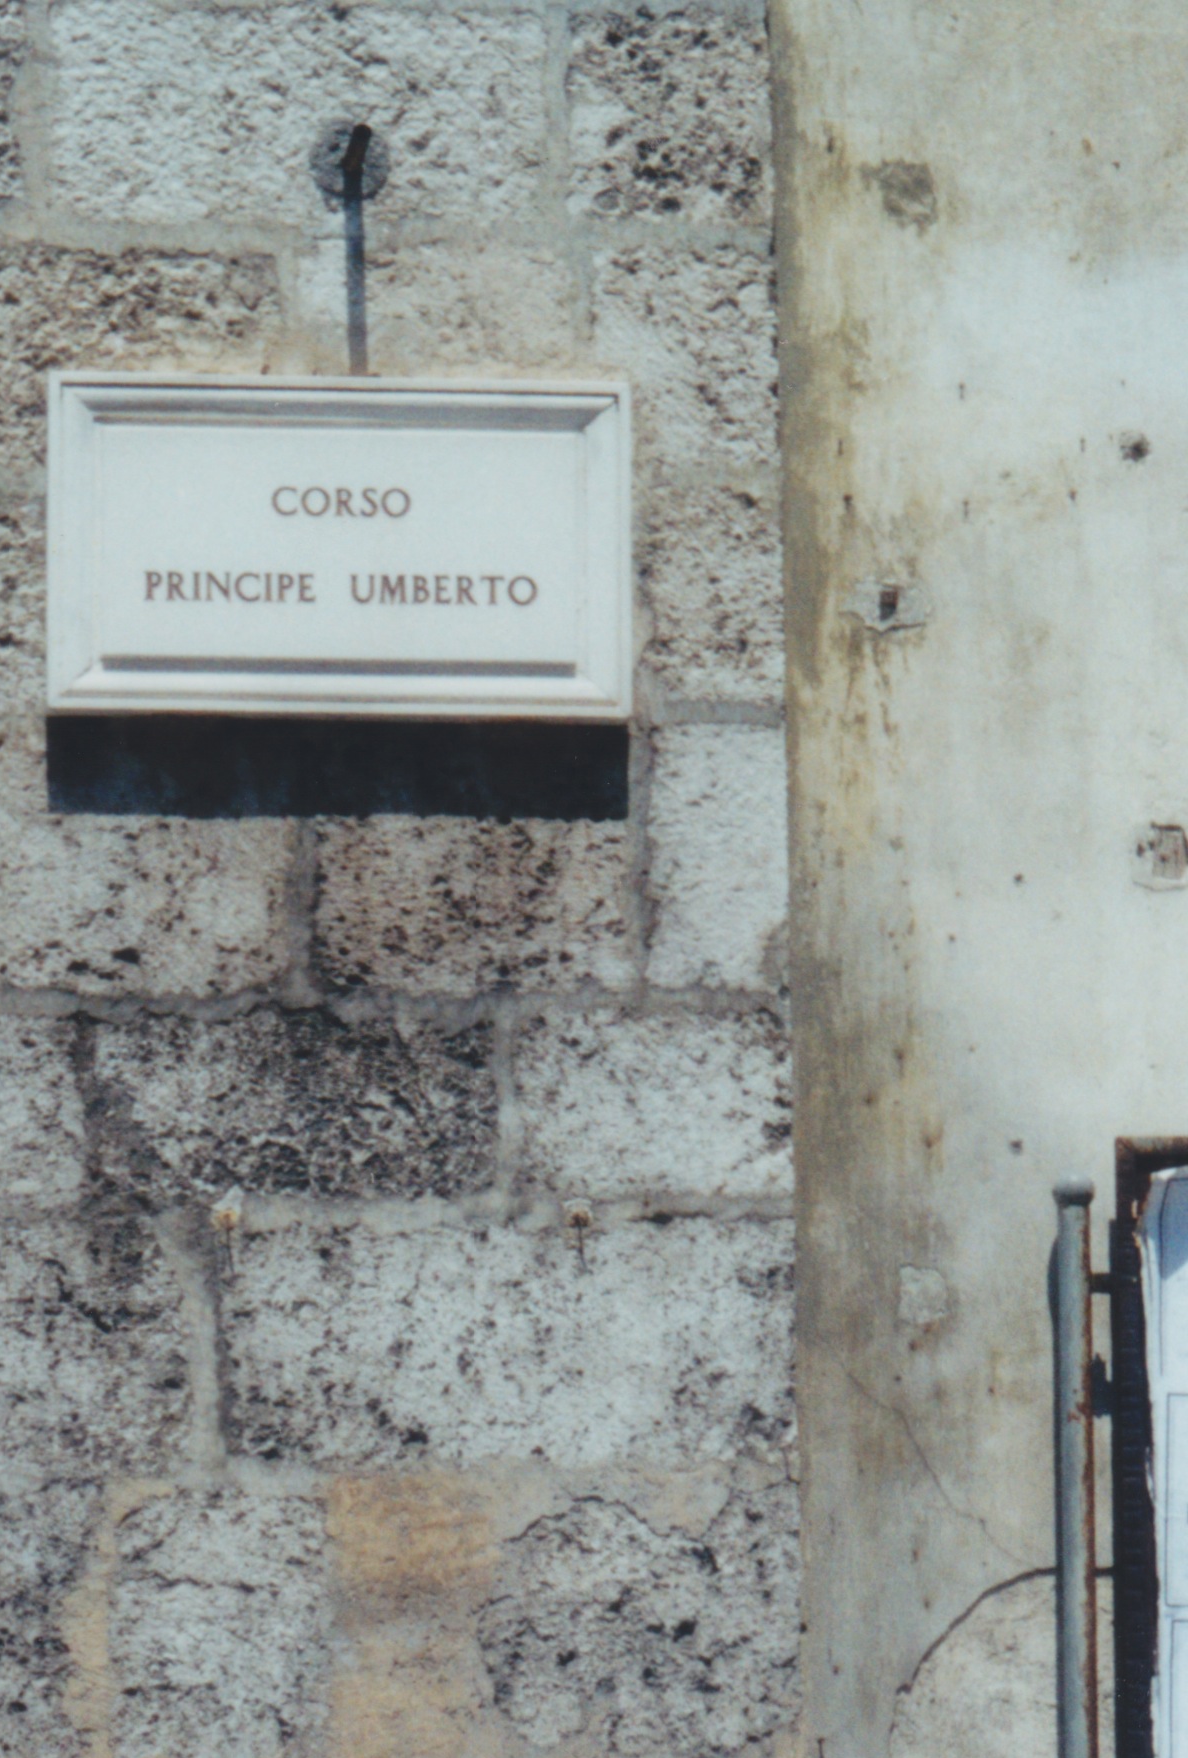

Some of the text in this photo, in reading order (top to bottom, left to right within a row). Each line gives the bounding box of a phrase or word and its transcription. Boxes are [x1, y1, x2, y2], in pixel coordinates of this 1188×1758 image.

[271, 486, 412, 518] CORSO
[144, 570, 539, 607] PRINCIPE UMBERTO
